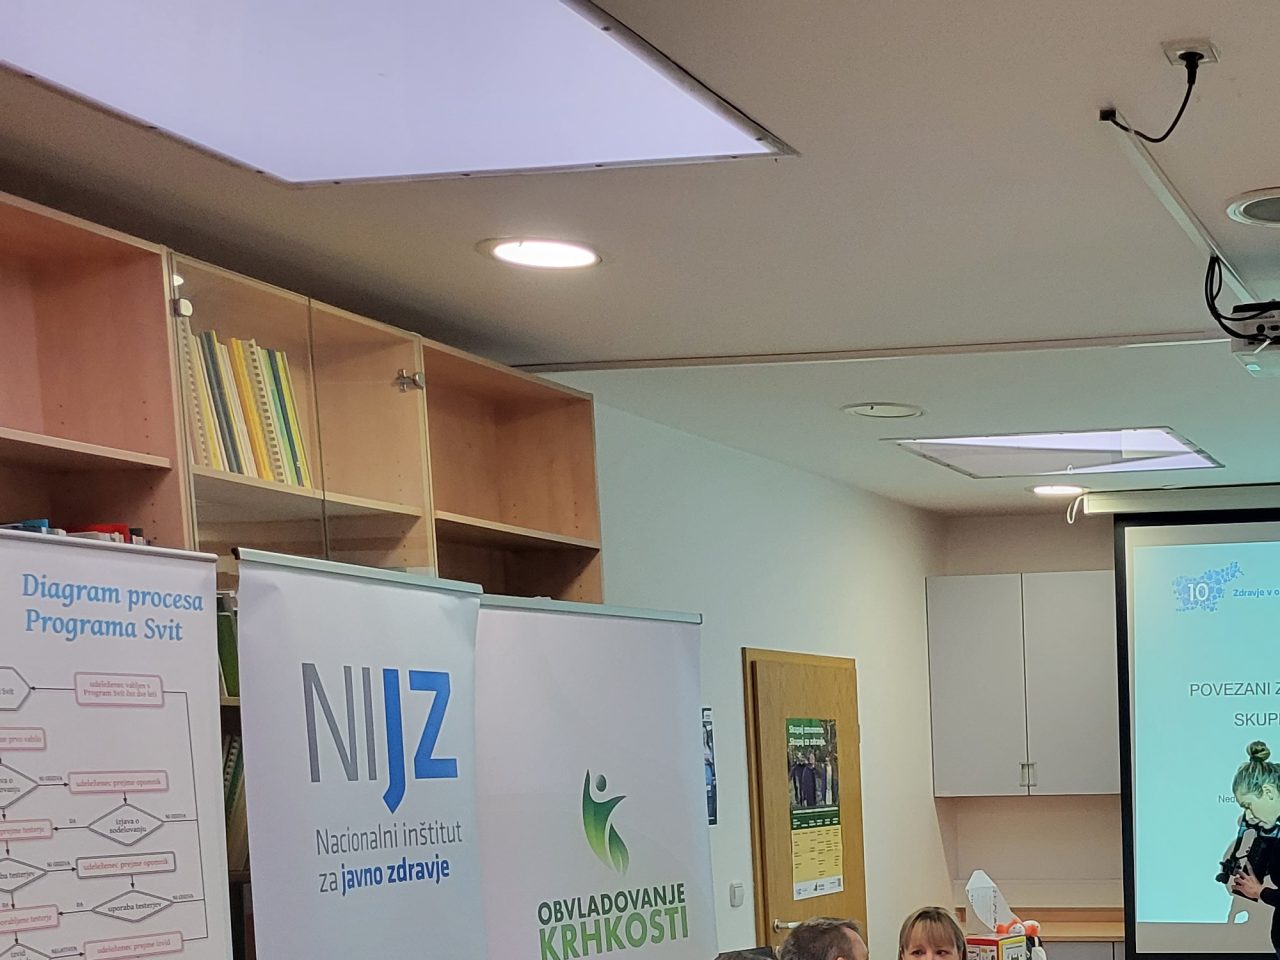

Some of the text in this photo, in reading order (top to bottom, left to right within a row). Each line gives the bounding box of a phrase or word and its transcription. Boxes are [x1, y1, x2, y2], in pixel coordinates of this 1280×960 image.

[22, 573, 204, 611] Diagram procesa
[1188, 583, 1209, 601] 10
[1233, 589, 1265, 598] Zdravje
[25, 609, 183, 641] Programa Svit
[1190, 682, 1271, 697] POVEZANI
[301, 662, 458, 814] NIJZ
[109, 826, 147, 834] sodelovanju
[115, 818, 135, 826] izjava
[315, 820, 463, 856] Nacionalni inštitut
[319, 853, 450, 896] za javno zdravje
[108, 903, 134, 913] uporaba
[537, 882, 686, 926] OBVLADOVANJE
